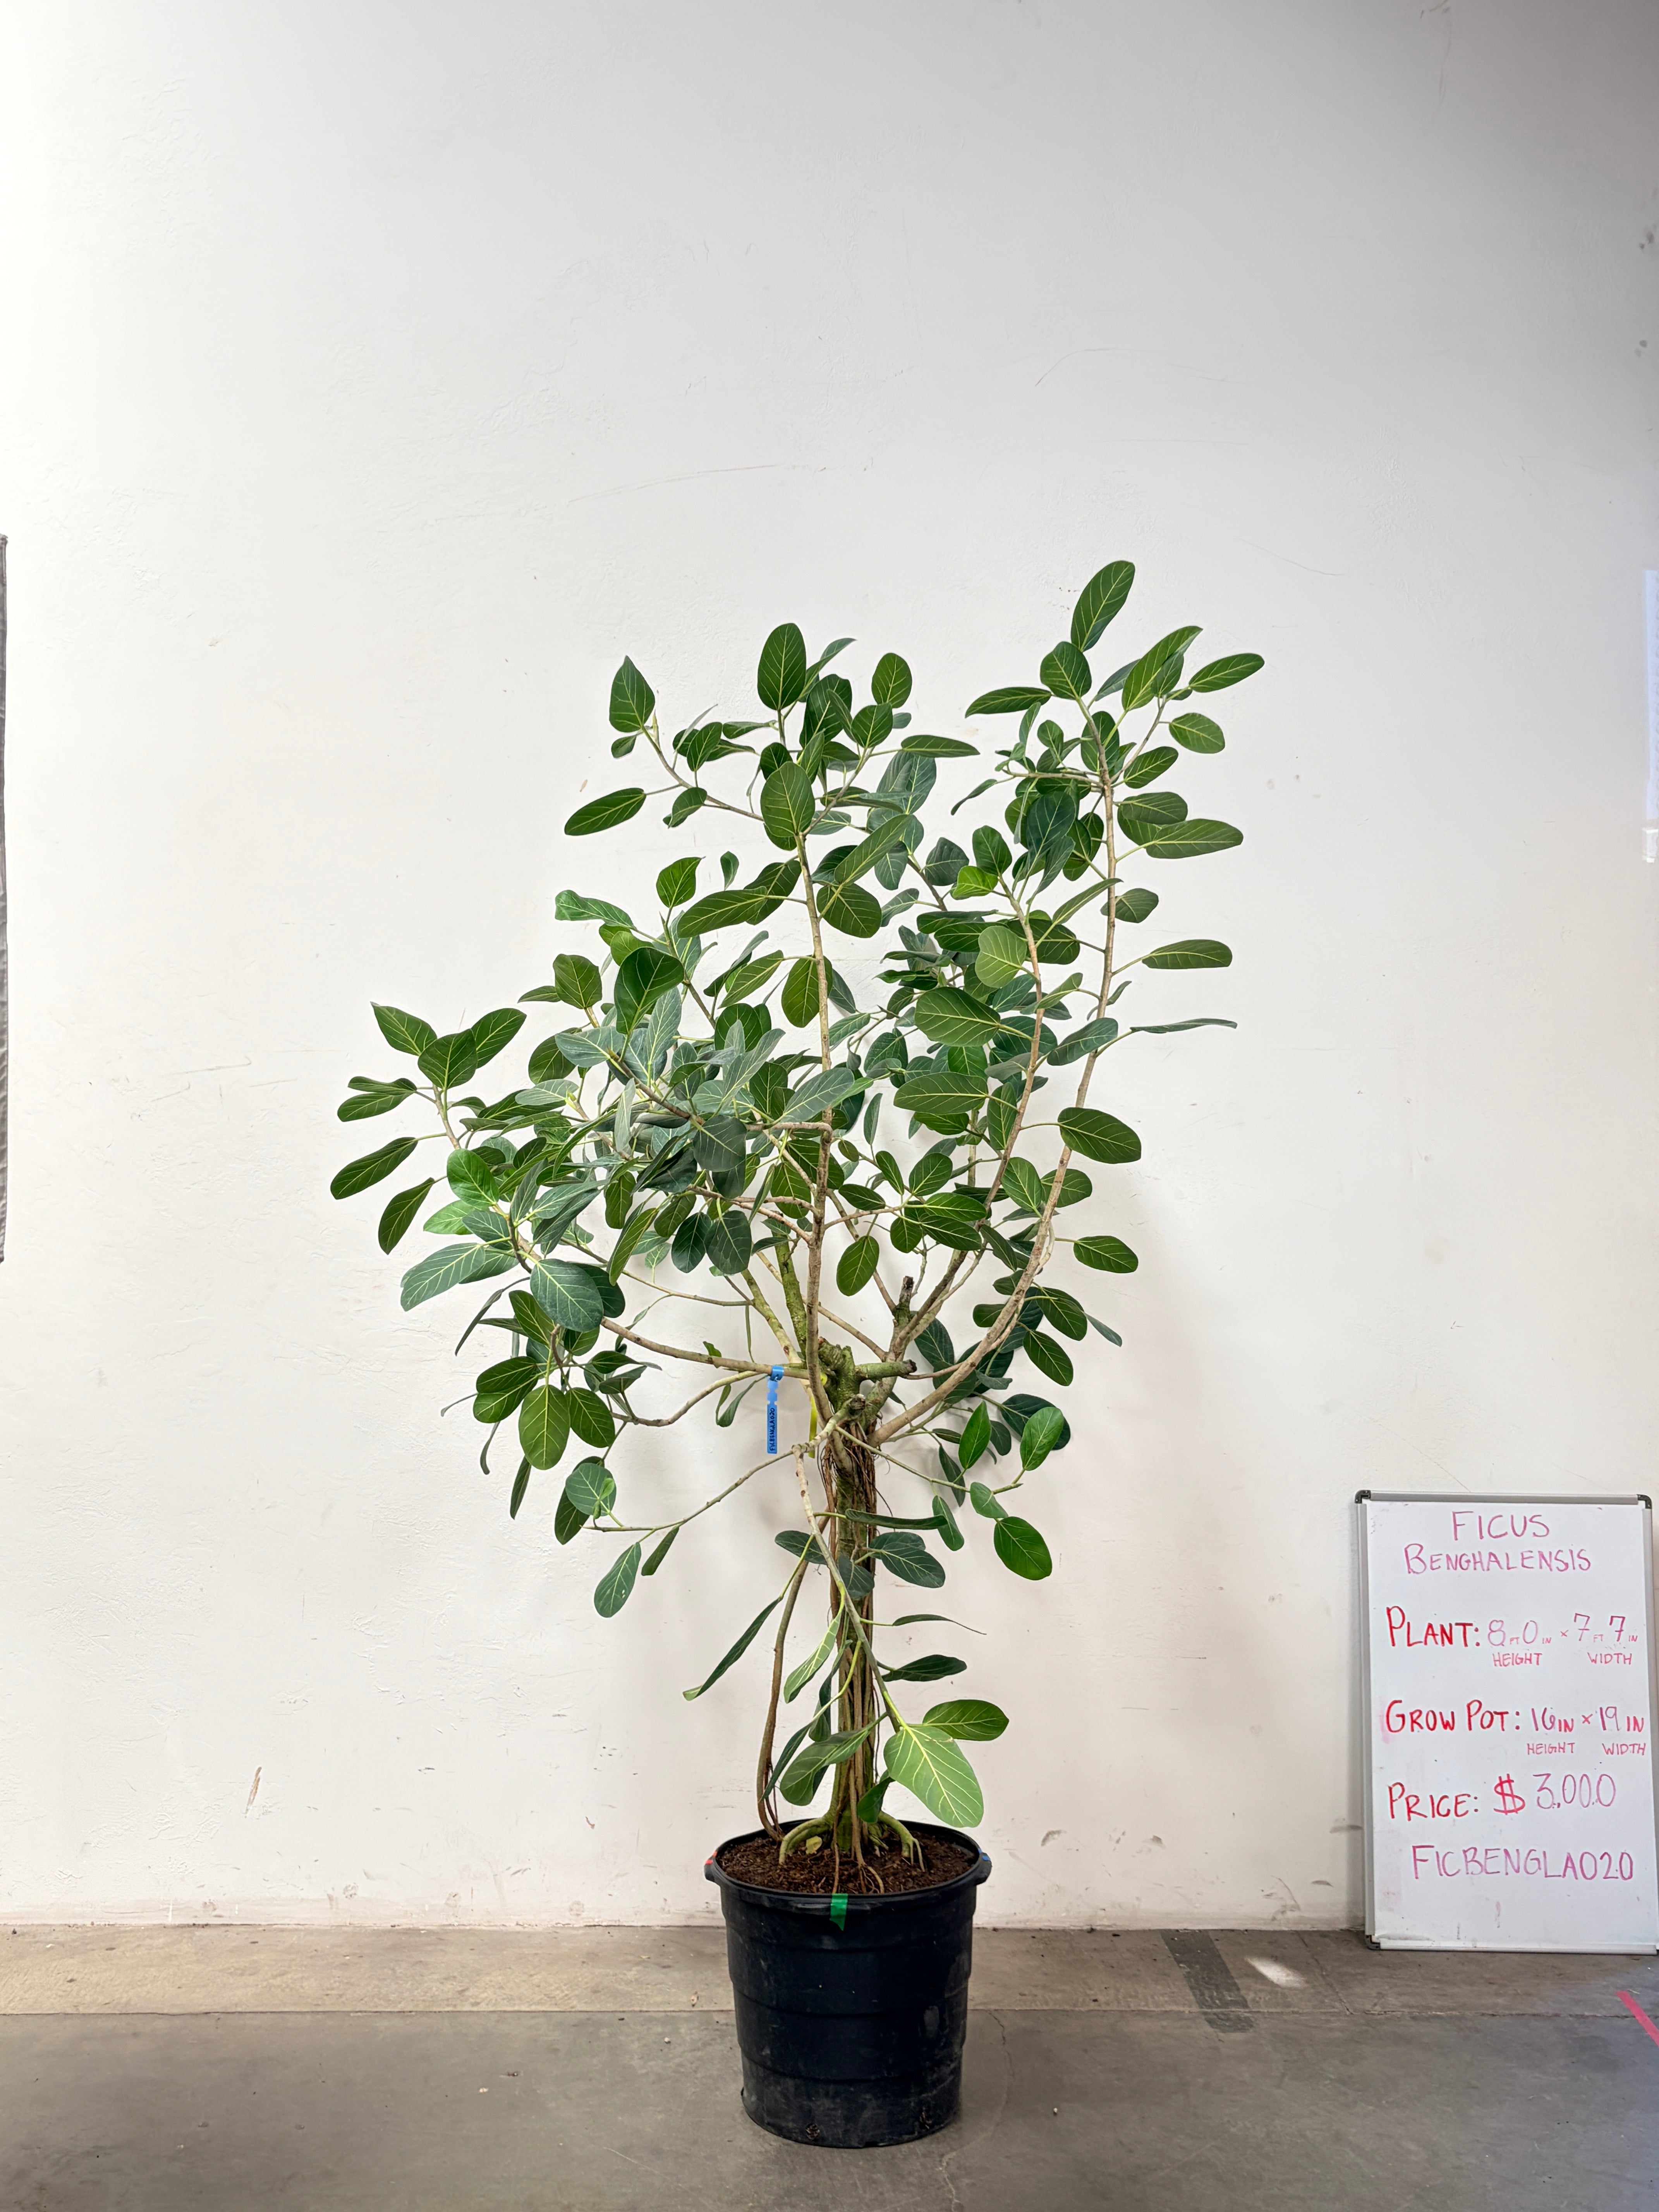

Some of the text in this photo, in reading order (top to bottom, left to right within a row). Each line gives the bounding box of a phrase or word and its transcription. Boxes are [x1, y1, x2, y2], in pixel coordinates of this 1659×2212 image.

[1452, 1511, 1549, 1540] FICUS
[1404, 1543, 1591, 1575] BENGHALENSIS
[1386, 1606, 1480, 1647] PLANT:
[1493, 1652, 1632, 1667] HEIGHT WIDTH
[1386, 1700, 1455, 1733] GROW
[1466, 1699, 1520, 1731] POT:
[1527, 1742, 1646, 1756] HEIGHT WIDTH
[1388, 1782, 1479, 1822] PRICE:
[1412, 1844, 1633, 1881] FICBENGLA020
